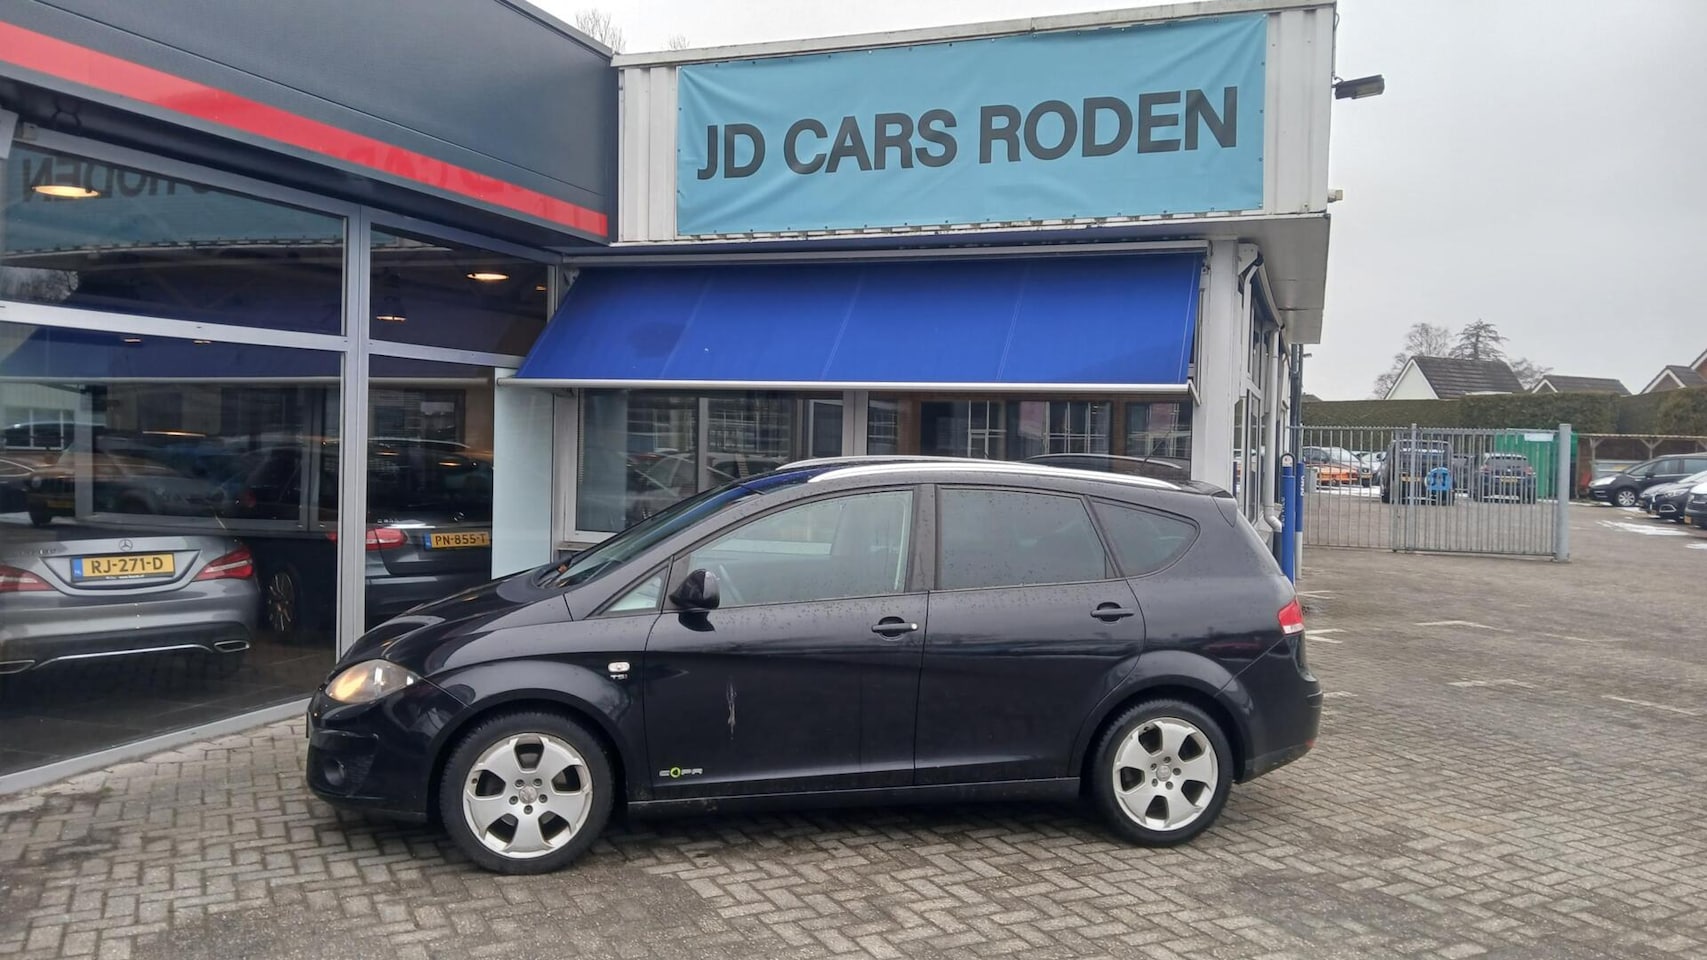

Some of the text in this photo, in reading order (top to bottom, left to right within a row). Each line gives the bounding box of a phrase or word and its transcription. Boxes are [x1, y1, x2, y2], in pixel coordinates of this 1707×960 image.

[697, 86, 1238, 180] JD CARS RODEN
[434, 534, 486, 546] PN-855-T
[91, 557, 163, 574] RJ-271-D
